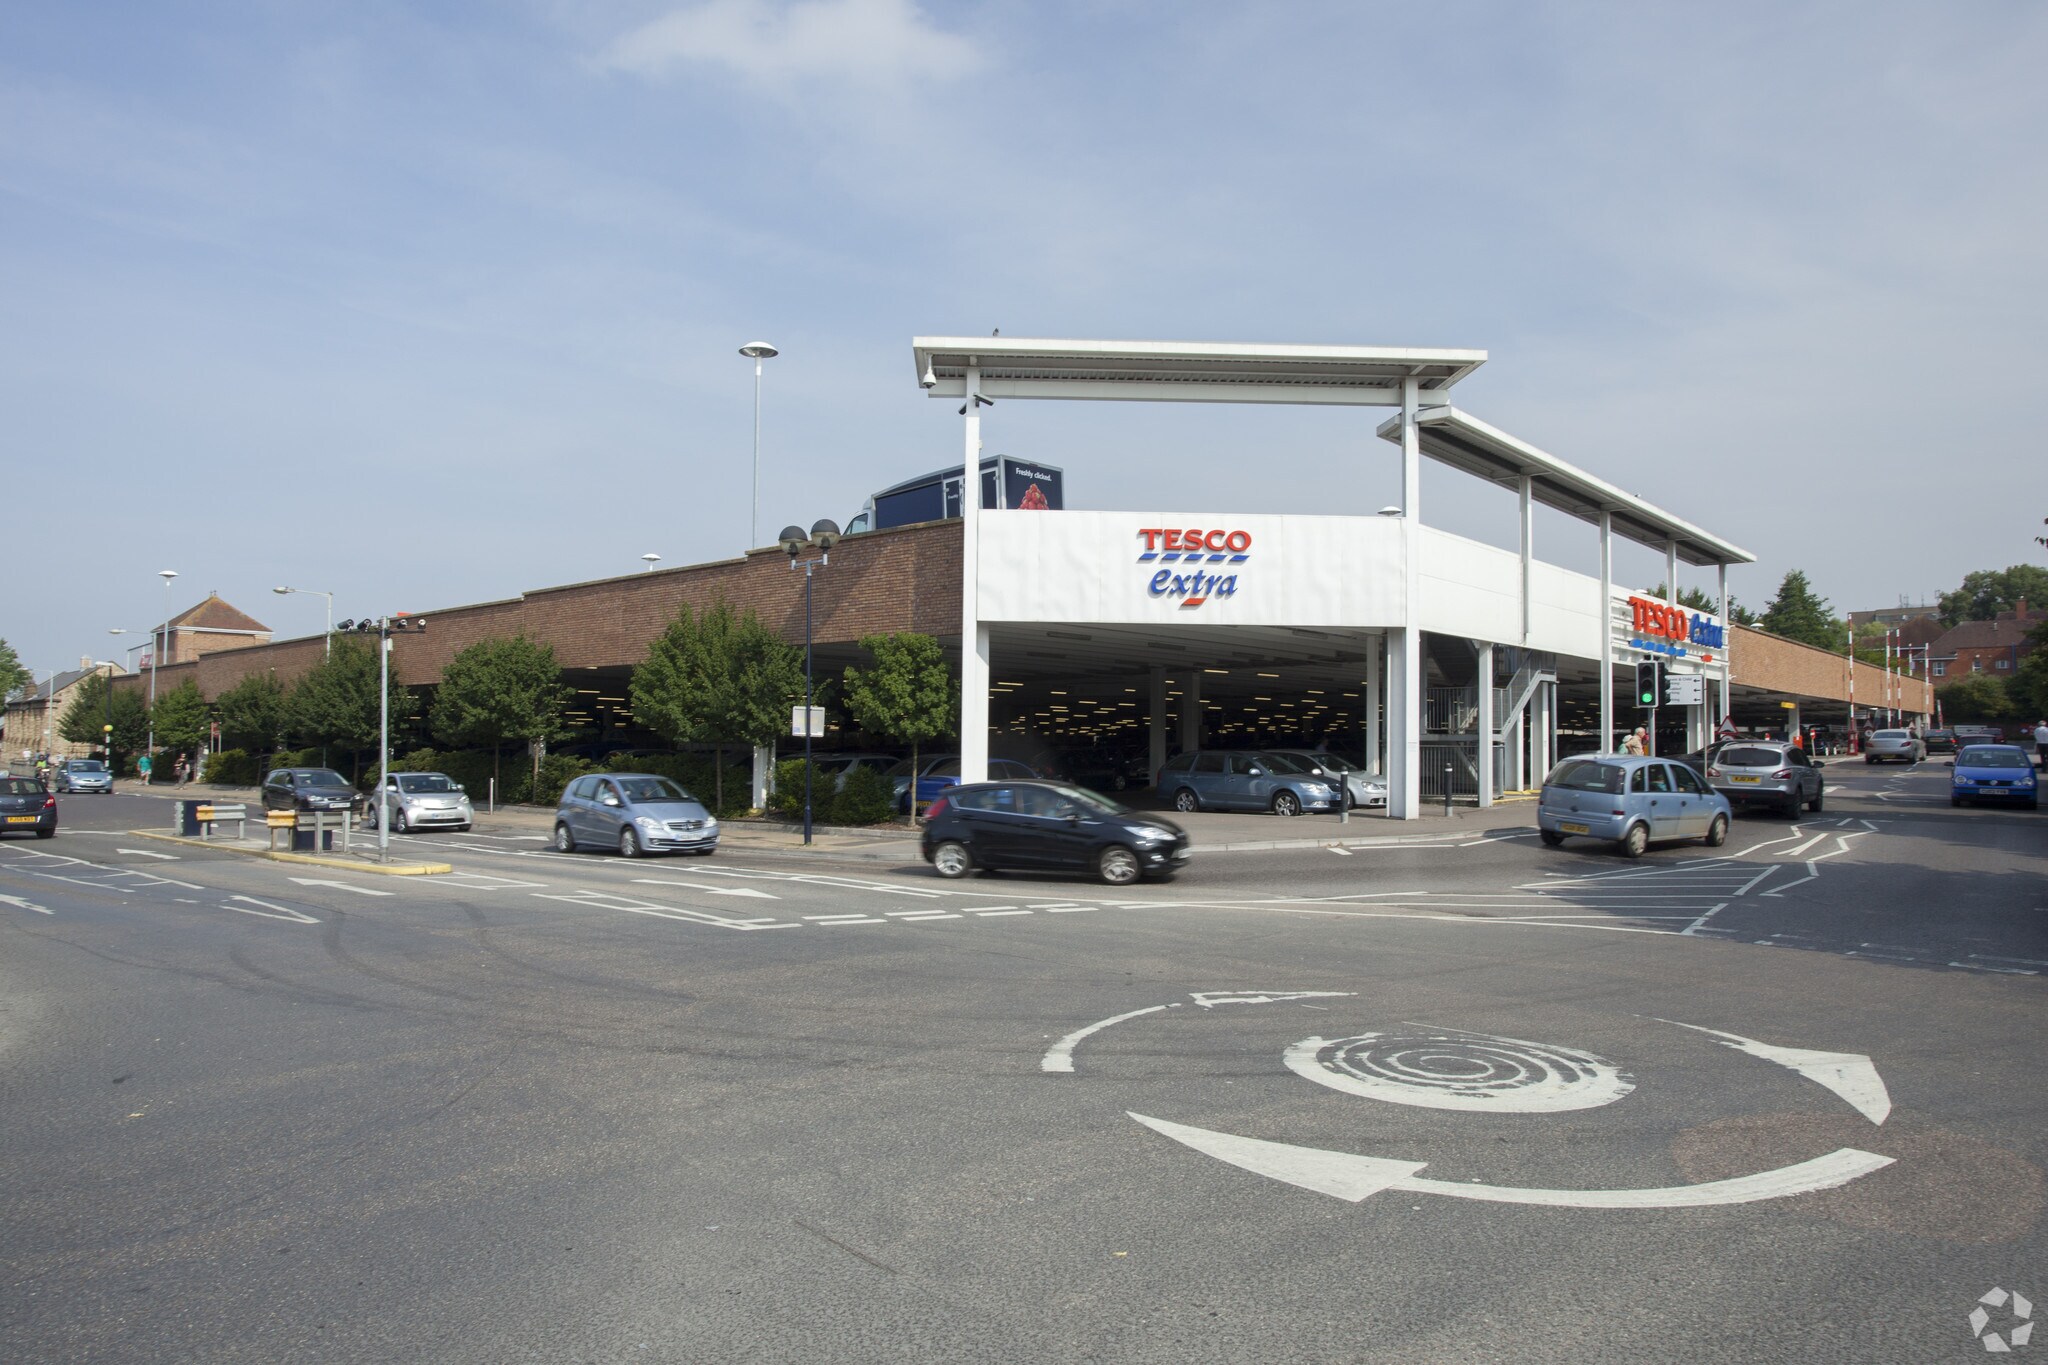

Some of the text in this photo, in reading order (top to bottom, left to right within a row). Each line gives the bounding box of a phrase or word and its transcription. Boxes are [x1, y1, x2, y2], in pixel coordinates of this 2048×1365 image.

[1015, 467, 1033, 479] Freshly
[1138, 528, 1252, 552] TESCO
[1149, 568, 1239, 596] extra
[1629, 596, 1723, 649] TESCO extra
